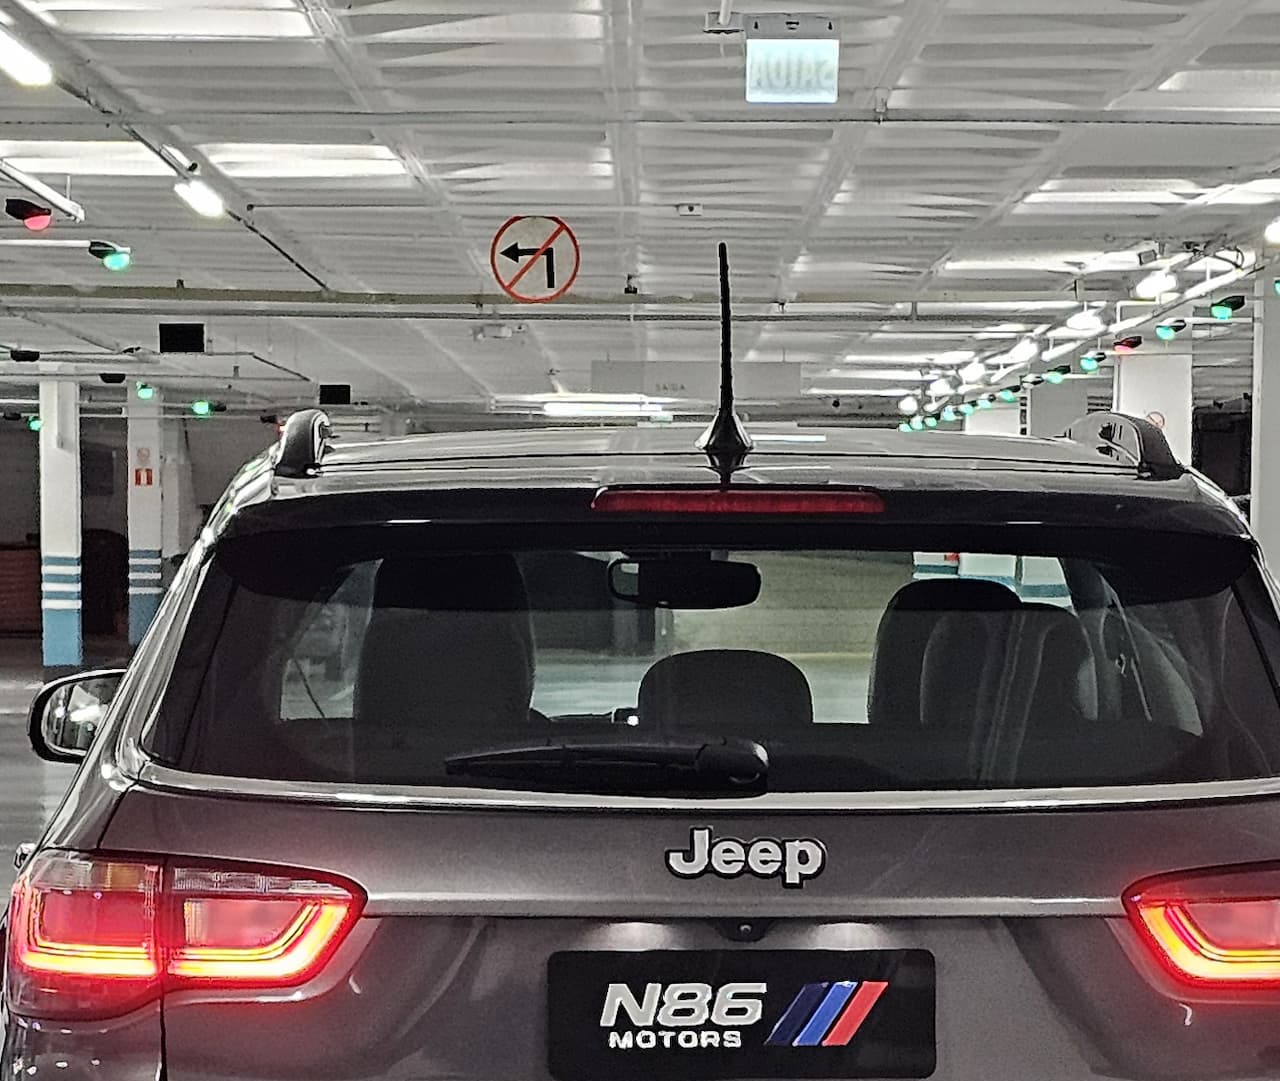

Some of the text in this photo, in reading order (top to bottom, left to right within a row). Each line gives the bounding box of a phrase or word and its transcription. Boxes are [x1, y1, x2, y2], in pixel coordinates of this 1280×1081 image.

[667, 827, 825, 887] Jeep
[599, 982, 767, 1027] N86
[609, 1030, 742, 1049] MOTORS
